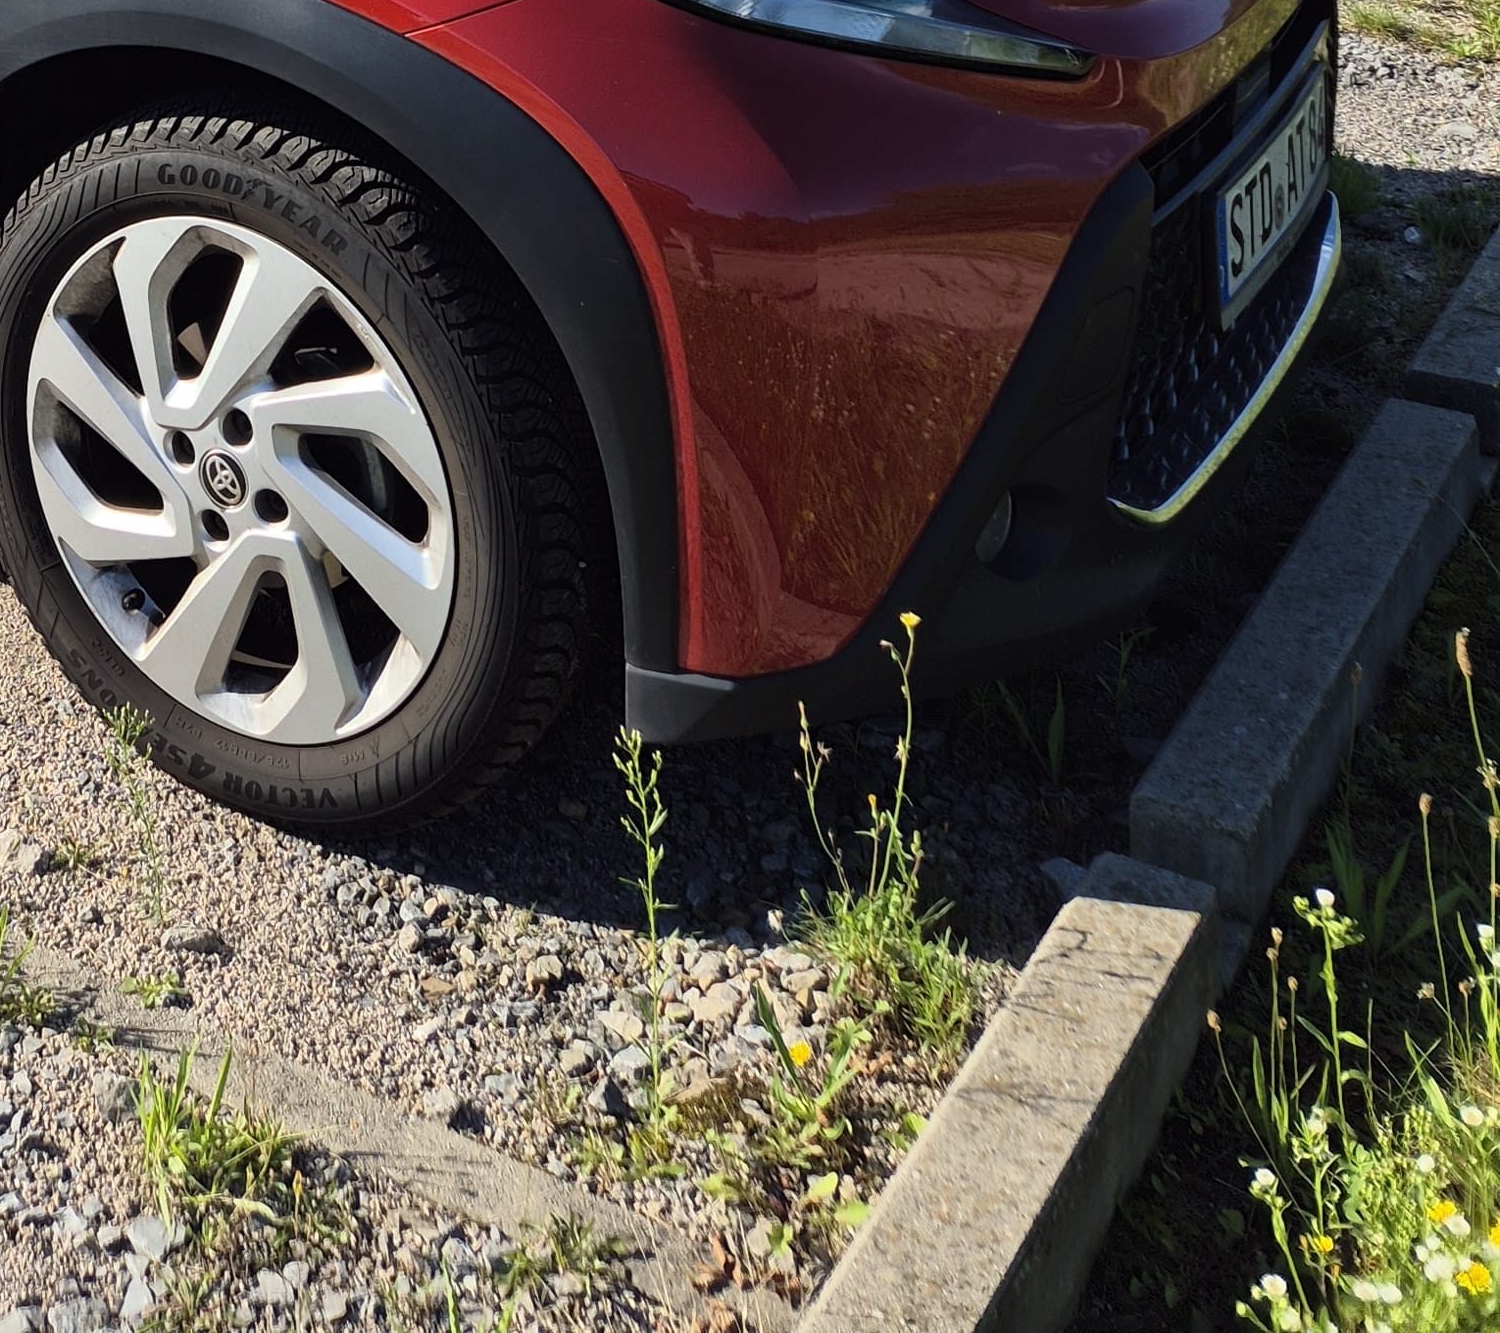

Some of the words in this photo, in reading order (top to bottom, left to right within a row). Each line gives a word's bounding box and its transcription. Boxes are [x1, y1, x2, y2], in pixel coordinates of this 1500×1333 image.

[157, 163, 349, 255] GOODYEAR
[1229, 161, 1274, 278] STD
[66, 647, 216, 780] 4SEONS
[223, 770, 339, 810] VECTOR
